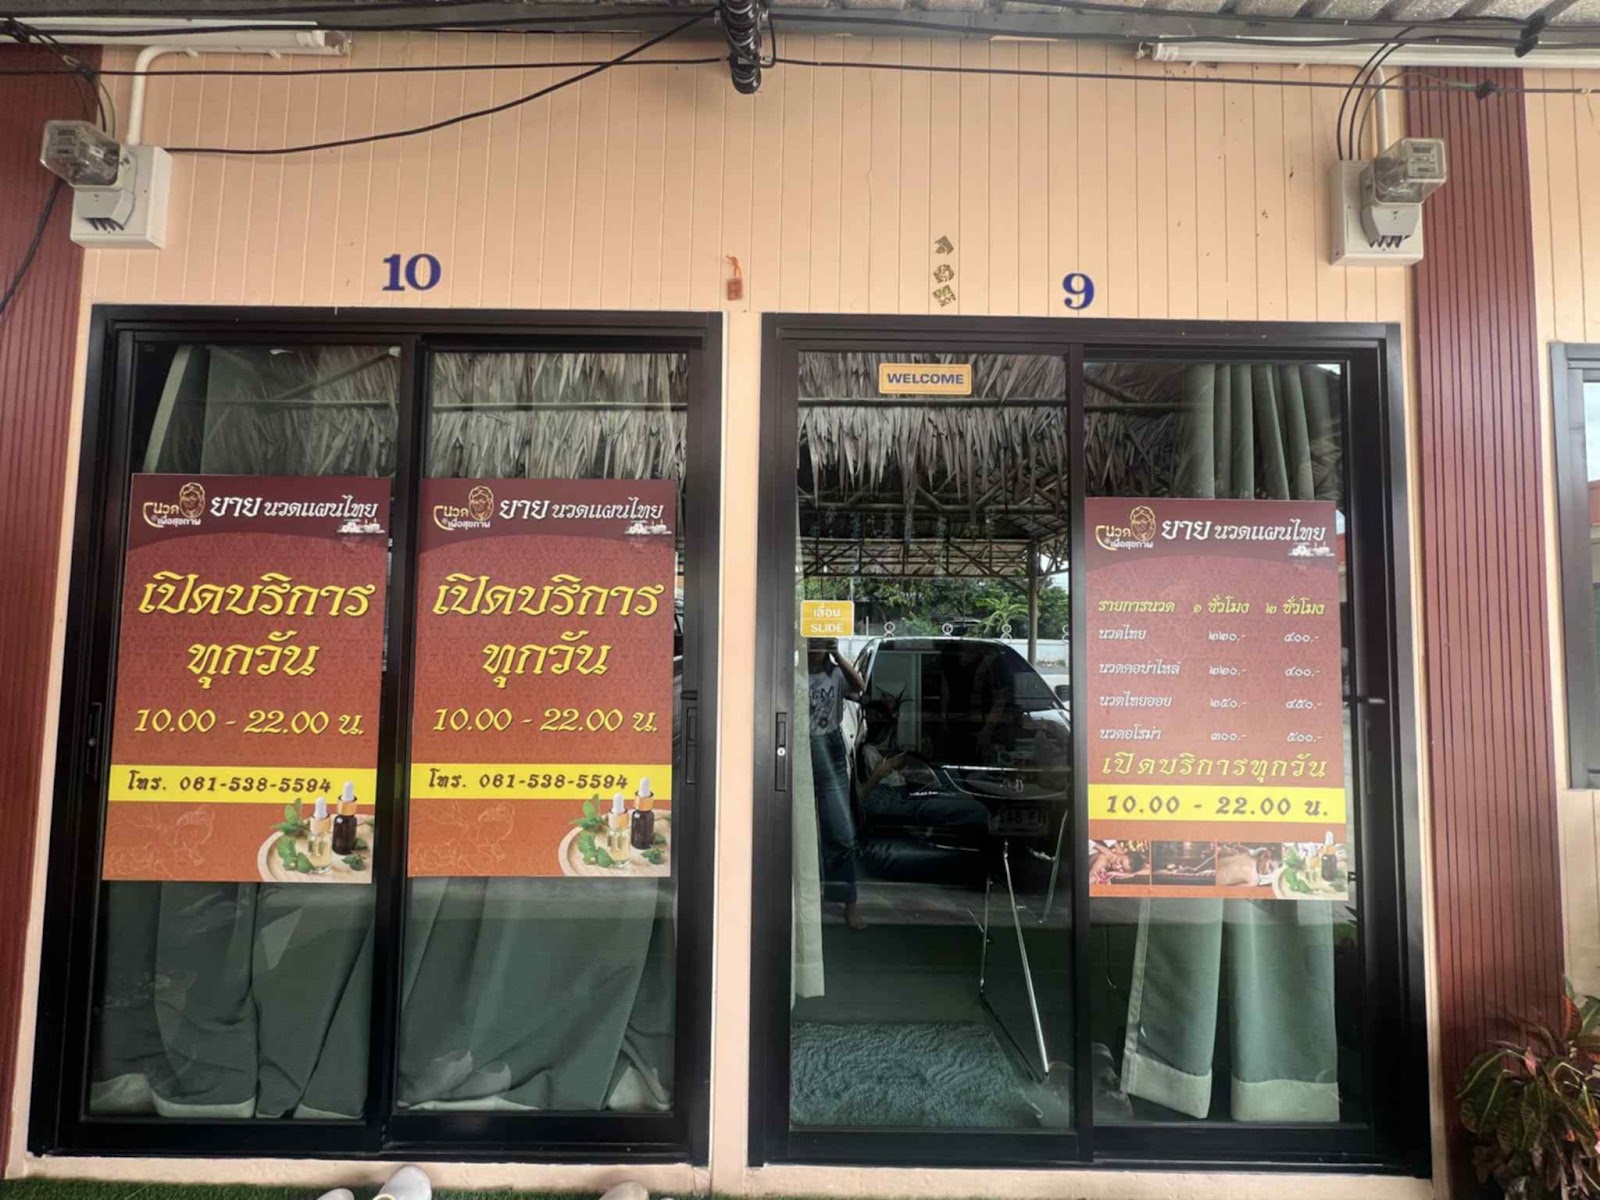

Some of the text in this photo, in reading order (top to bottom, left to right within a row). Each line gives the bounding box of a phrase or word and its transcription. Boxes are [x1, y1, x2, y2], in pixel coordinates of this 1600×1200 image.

[382, 253, 442, 291] 10
[1062, 273, 1095, 310] 9
[887, 373, 965, 385] WELCOME
[210, 494, 379, 518] ยาย นวดแผนไทย
[499, 496, 665, 520] ยาย นวดแผนไทย
[1161, 518, 1326, 541] ยาย นวดแผนไทย
[137, 570, 376, 617] เปิดบริการ
[432, 572, 665, 617] เปิดบริการ
[1098, 598, 1176, 613] รายการนวด
[1207, 594, 1250, 614] ชั่วโมง
[1282, 596, 1326, 615] ชั่วโมง
[810, 623, 844, 633] SLIDE
[1098, 624, 1147, 641] นวดไทย
[187, 630, 321, 690] ทุกวัน
[482, 630, 612, 689] ทุกวัน
[134, 708, 217, 734] 10.00
[243, 709, 330, 735] 22.00
[337, 714, 365, 736] น.
[432, 707, 513, 732] 10.00
[540, 708, 624, 733] 22.00
[632, 711, 659, 733] น.
[1099, 724, 1162, 741] นวดอโรม่า
[428, 768, 467, 789] โทร.
[1101, 751, 1327, 785] เปิดบริการทุกวัน
[127, 770, 167, 791] โทร.
[1106, 795, 1180, 814] 10.00
[1215, 796, 1292, 816] 22.00
[1304, 799, 1329, 817] น.
